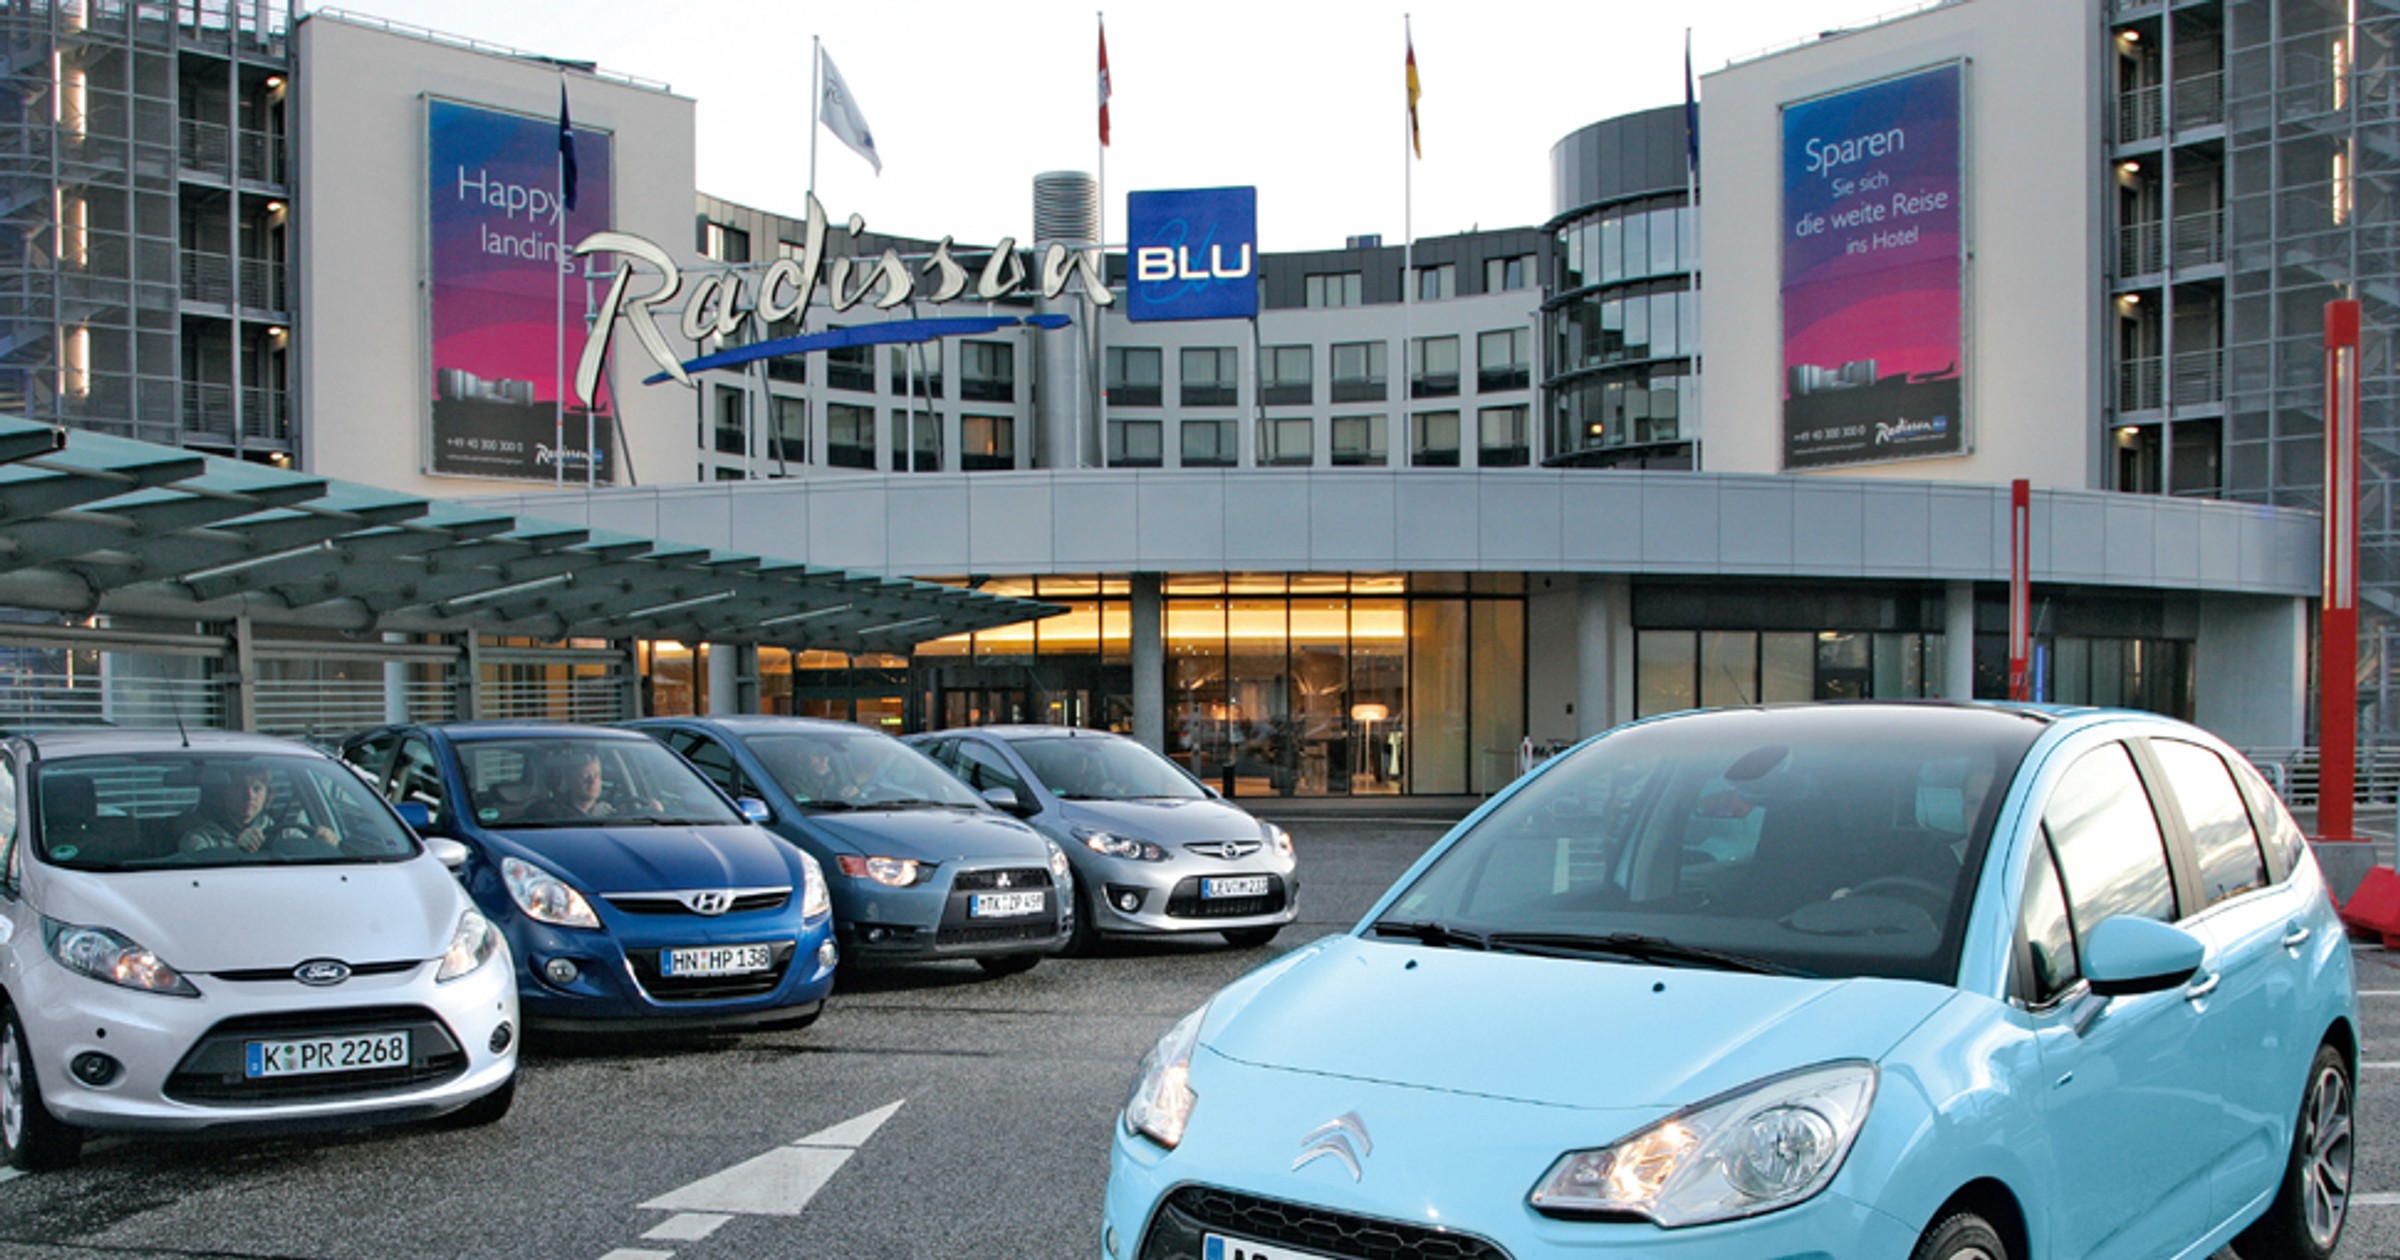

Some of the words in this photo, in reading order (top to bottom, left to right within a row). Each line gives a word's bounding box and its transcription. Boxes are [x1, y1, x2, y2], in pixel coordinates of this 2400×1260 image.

[1805, 128, 1904, 178] Sparen
[459, 165, 565, 226] Happy
[1832, 178, 1854, 198] Sie
[1859, 170, 1889, 192] sich
[1796, 212, 1825, 237] die
[1831, 201, 1885, 228] weite
[1893, 189, 1948, 218] Reise
[482, 222, 575, 274] landing
[1847, 238, 1867, 255] ins
[1873, 225, 1919, 250] Hotel
[573, 190, 1114, 402] Radisson
[1138, 243, 1250, 281] BLU
[980, 896, 1001, 911] MTK
[672, 952, 699, 971] HN
[710, 950, 733, 969] HP
[737, 948, 769, 968] 138
[264, 1046, 280, 1071] K
[301, 1043, 335, 1068] PR
[341, 1037, 404, 1066] 2268
